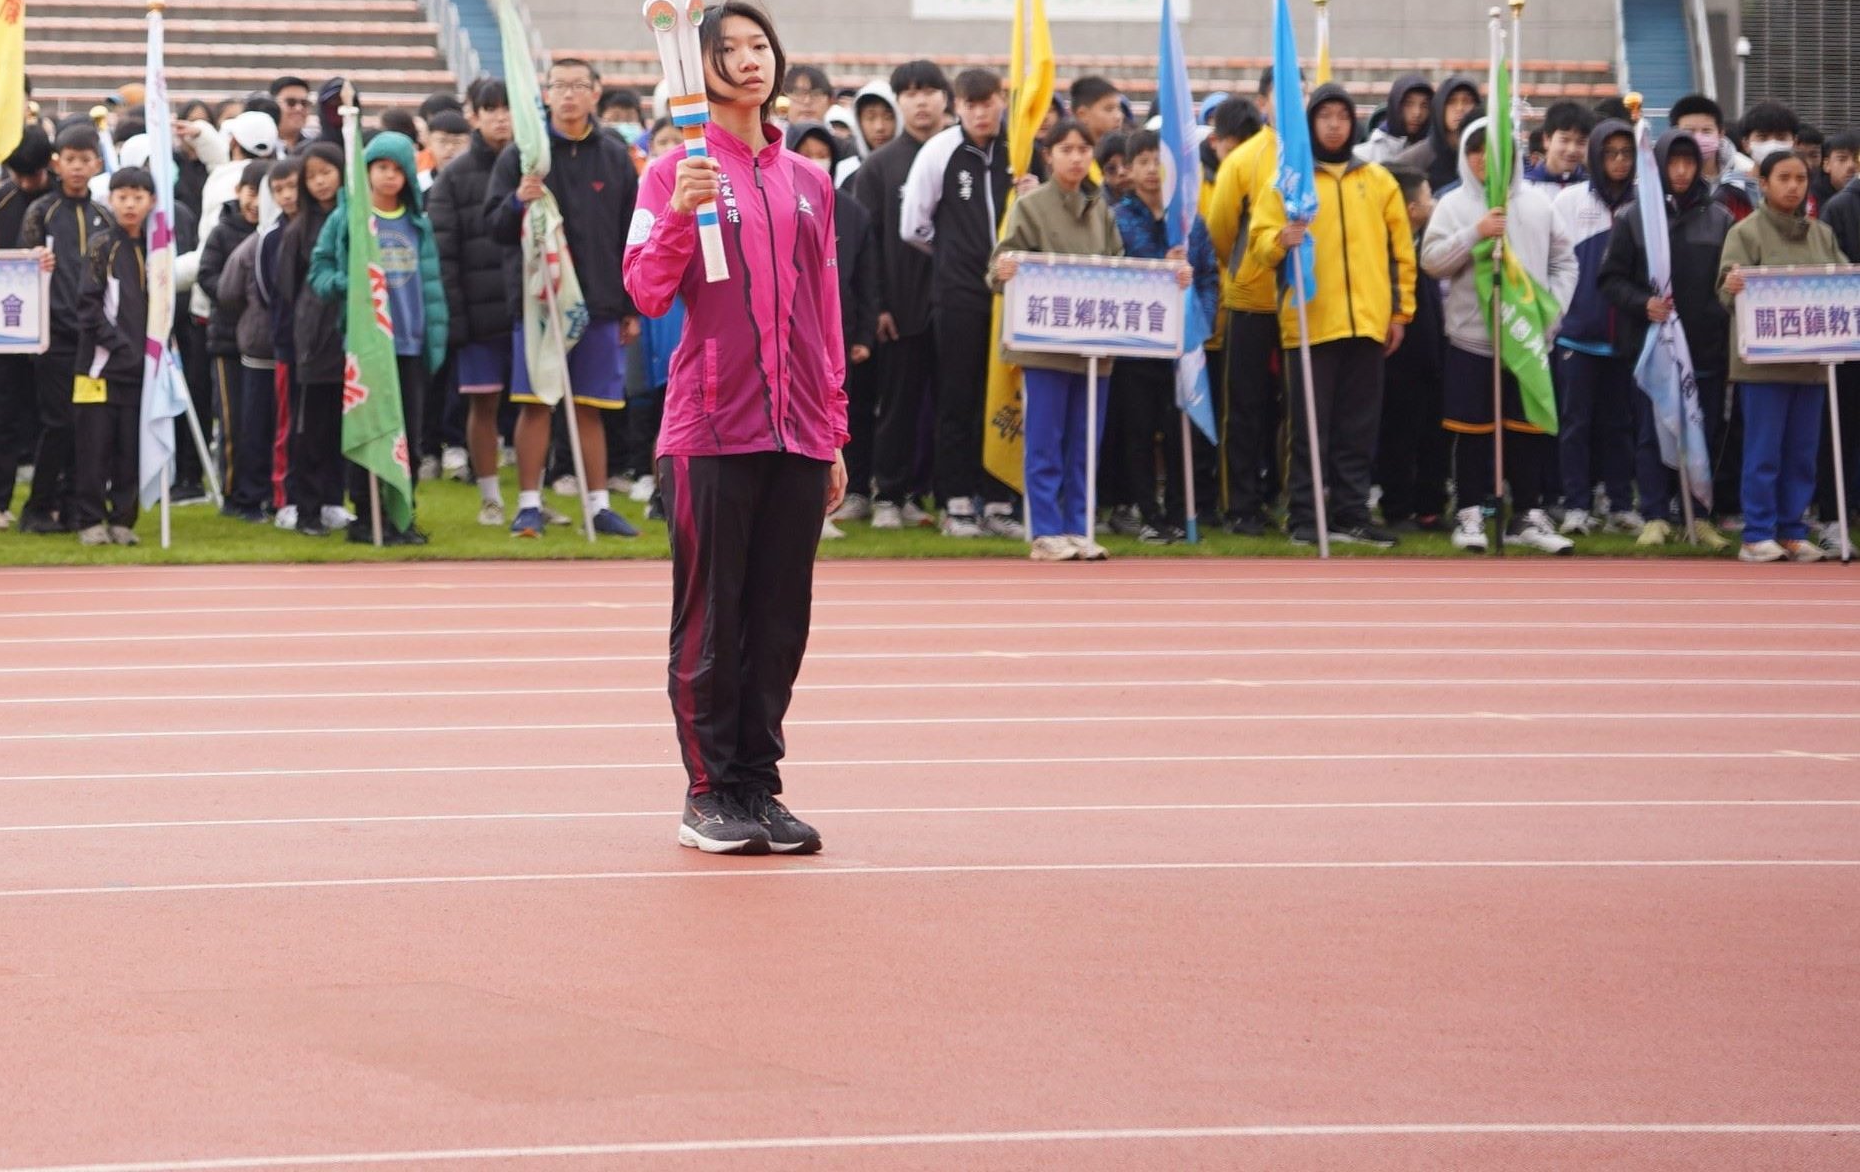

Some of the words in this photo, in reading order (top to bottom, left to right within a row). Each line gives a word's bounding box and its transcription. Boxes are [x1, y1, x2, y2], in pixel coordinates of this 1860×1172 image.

[1026, 294, 1167, 333] 新豐鄉教育會
